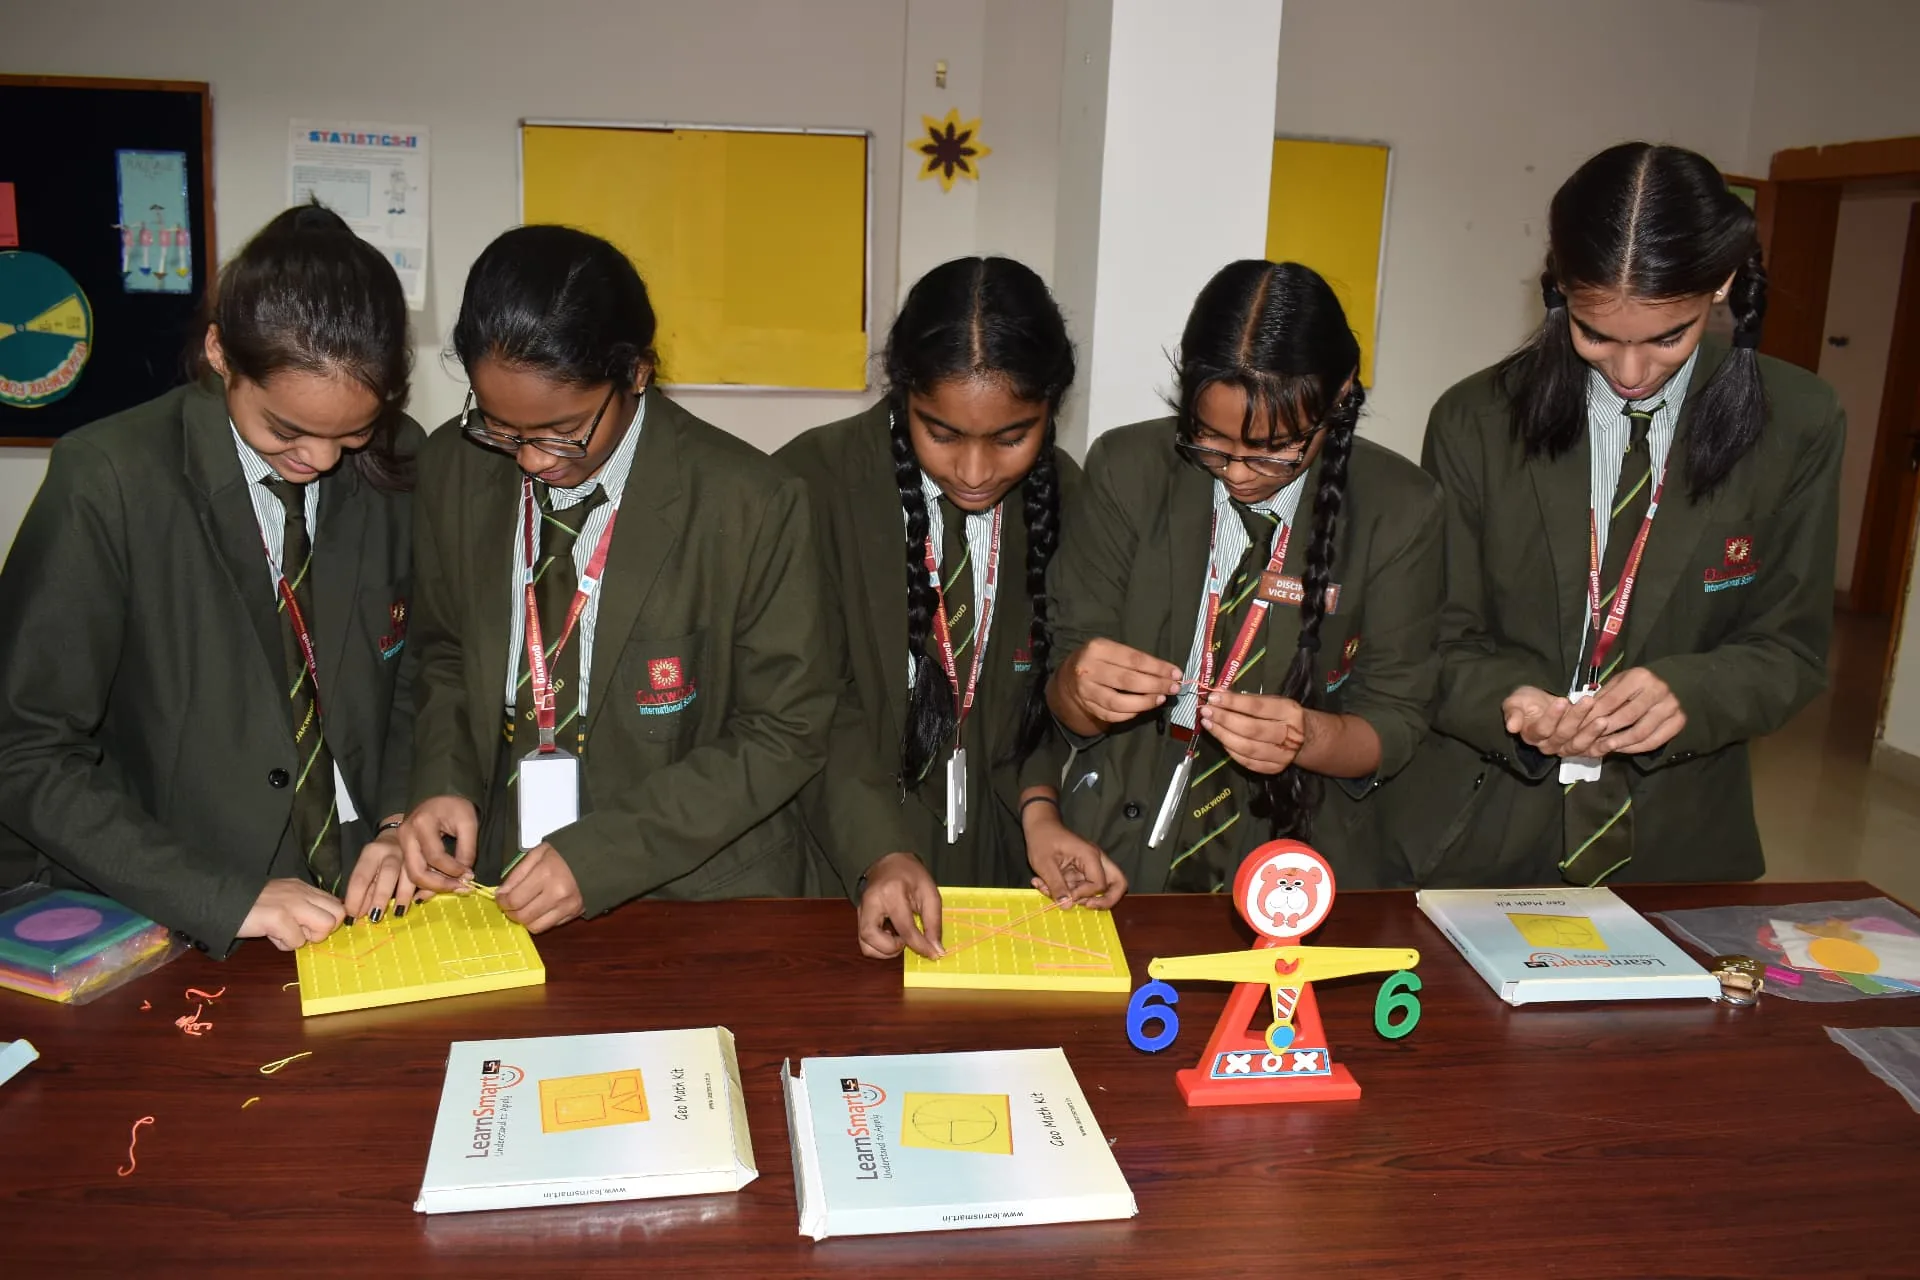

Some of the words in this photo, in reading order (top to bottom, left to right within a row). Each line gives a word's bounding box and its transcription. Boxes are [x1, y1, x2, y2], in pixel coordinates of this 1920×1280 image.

[1268, 587, 1287, 598] VICE
[1590, 570, 1599, 610] OAKWOOD
[1614, 577, 1634, 615] OAKWOOD
[532, 644, 546, 684] OAKWOOD
[942, 641, 956, 677] OAKWOOD
[1202, 651, 1213, 688] OAKWOOD
[1221, 658, 1240, 690] AKWOOD
[640, 701, 683, 716] International
[1193, 787, 1232, 819] OAKWOOD
[1551, 958, 1667, 969] LearnSmart
[1126, 980, 1179, 1052] 6
[1374, 969, 1423, 1039] 6
[670, 1068, 684, 1080] Kit
[672, 1081, 687, 1102] Math
[1029, 1092, 1046, 1104] Kit
[466, 1075, 499, 1158] LearnSmart
[674, 1105, 688, 1121] Geo
[869, 1114, 885, 1133] Apply
[1034, 1106, 1056, 1128] Math
[841, 1093, 878, 1180] LearnSmart
[1049, 1131, 1065, 1147] Geo
[875, 1142, 893, 1179] Understand
[543, 1187, 627, 1200] www.learnsmart.in
[942, 1211, 1024, 1223] www.learnsmart.in
